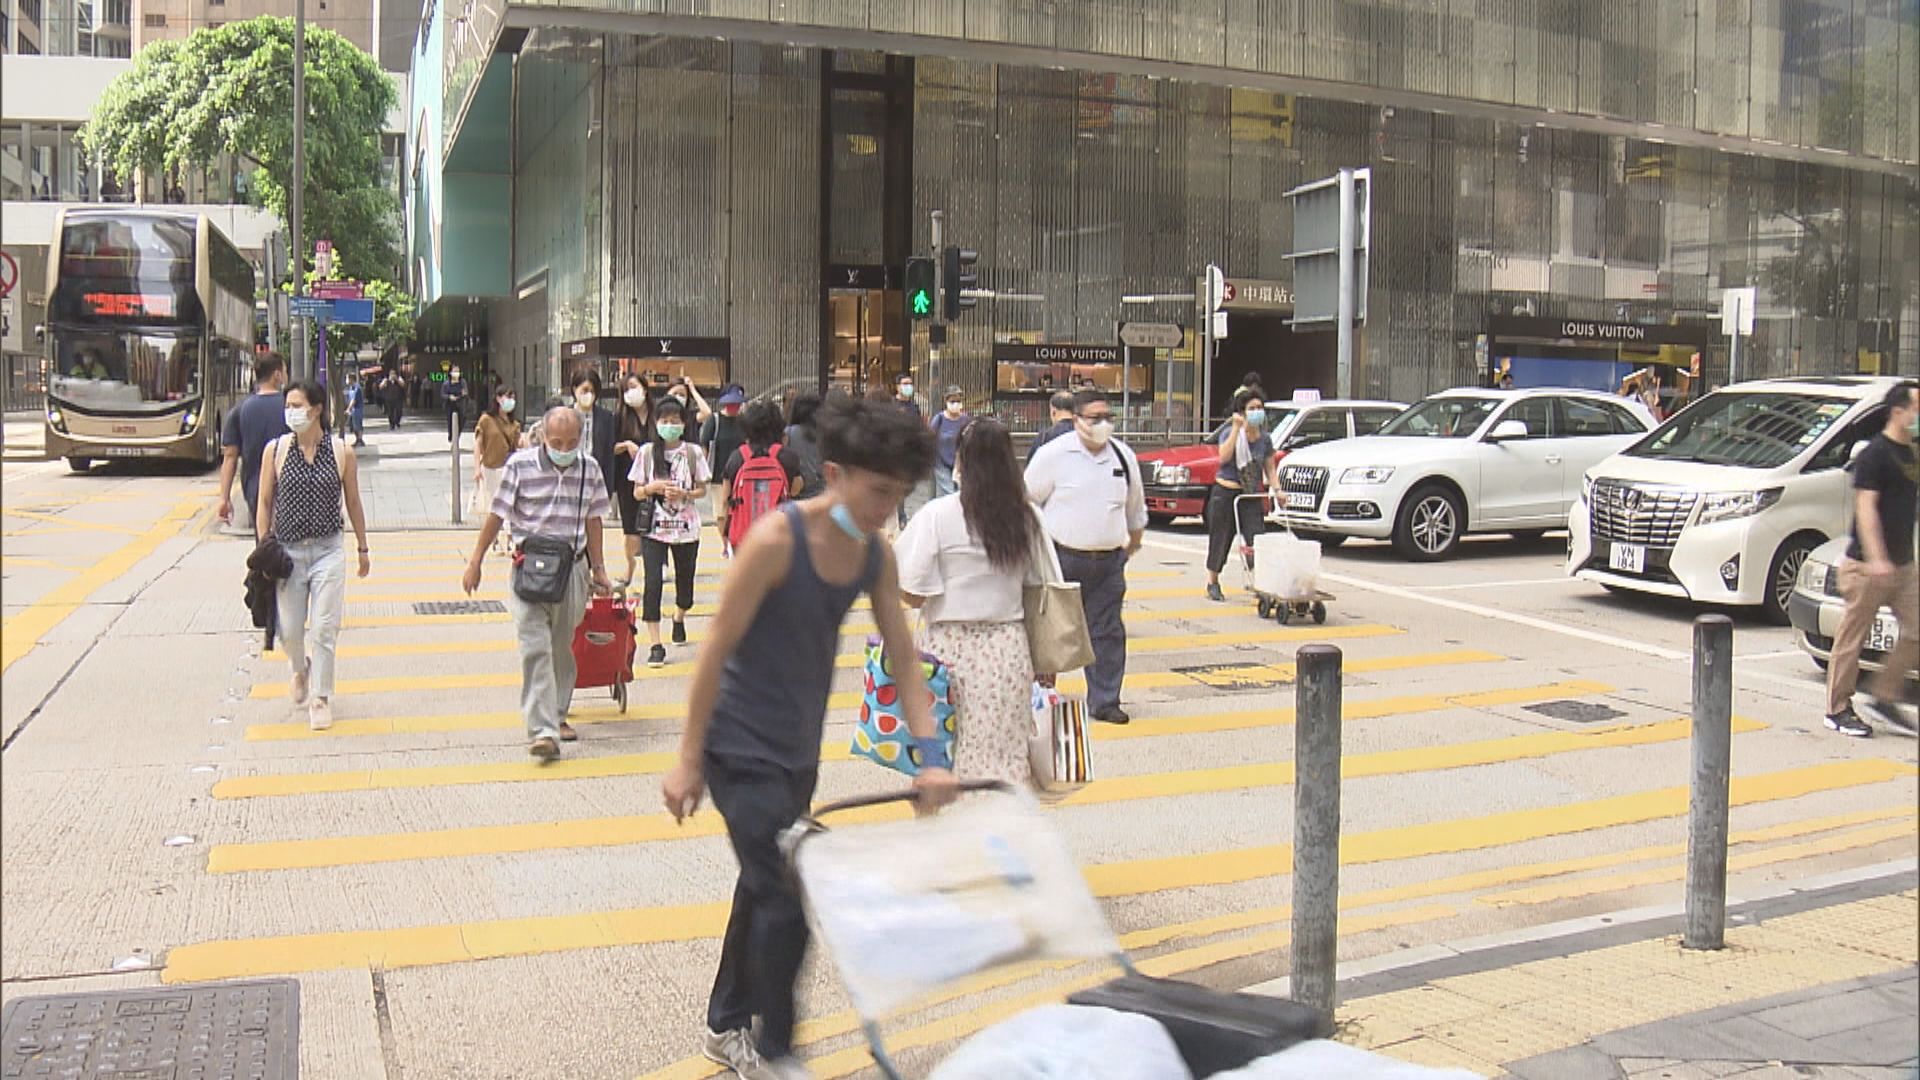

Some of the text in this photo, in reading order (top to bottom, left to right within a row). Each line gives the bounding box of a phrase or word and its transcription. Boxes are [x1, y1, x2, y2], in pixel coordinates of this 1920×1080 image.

[1243, 284, 1287, 303] 中環站
[1562, 322, 1644, 340] LOUIS VUITTON
[1035, 347, 1117, 360] LOUIS VUITTON
